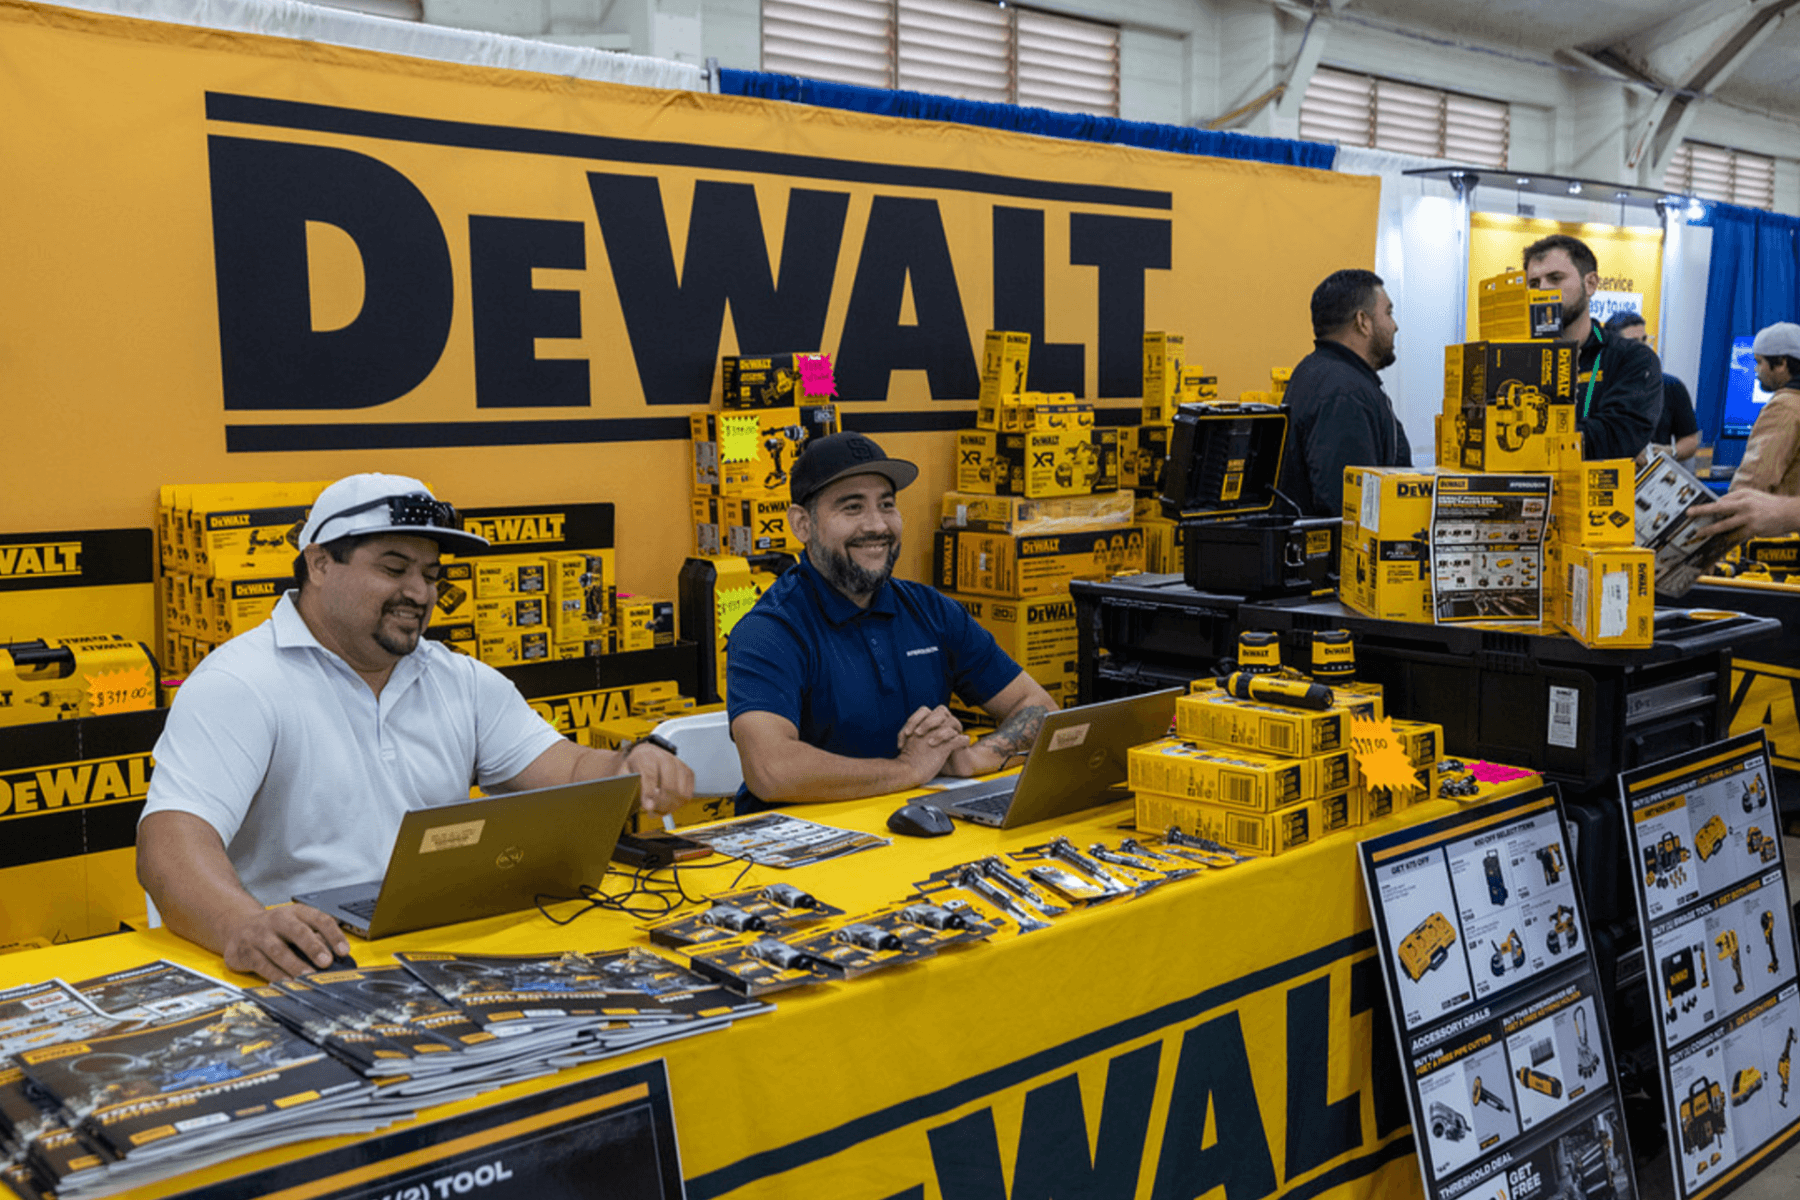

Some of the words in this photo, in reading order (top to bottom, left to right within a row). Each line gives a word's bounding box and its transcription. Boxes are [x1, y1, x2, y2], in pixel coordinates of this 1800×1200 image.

[206, 133, 1173, 412] DEWALT
[1557, 348, 1571, 397] DEWALT
[1032, 436, 1060, 446] DEWALT
[961, 450, 981, 465] XR
[1033, 452, 1055, 467] XR
[464, 516, 566, 542] DEWALT
[759, 518, 784, 534] XR
[1022, 538, 1060, 555] DEWALT
[236, 583, 276, 596] DEWALT
[1242, 650, 1270, 658] DEWALT
[1325, 647, 1351, 656] DEWALT
[1412, 1020, 1463, 1051] ACCESSORY
[1463, 1007, 1490, 1027] DEALS
[433, 1160, 513, 1199] TOOL
[1439, 1163, 1491, 1199] THRESHOLD
[1491, 1152, 1513, 1170] DEAL
[1509, 1161, 1532, 1185] GET
[1511, 1172, 1542, 1200] FREE
